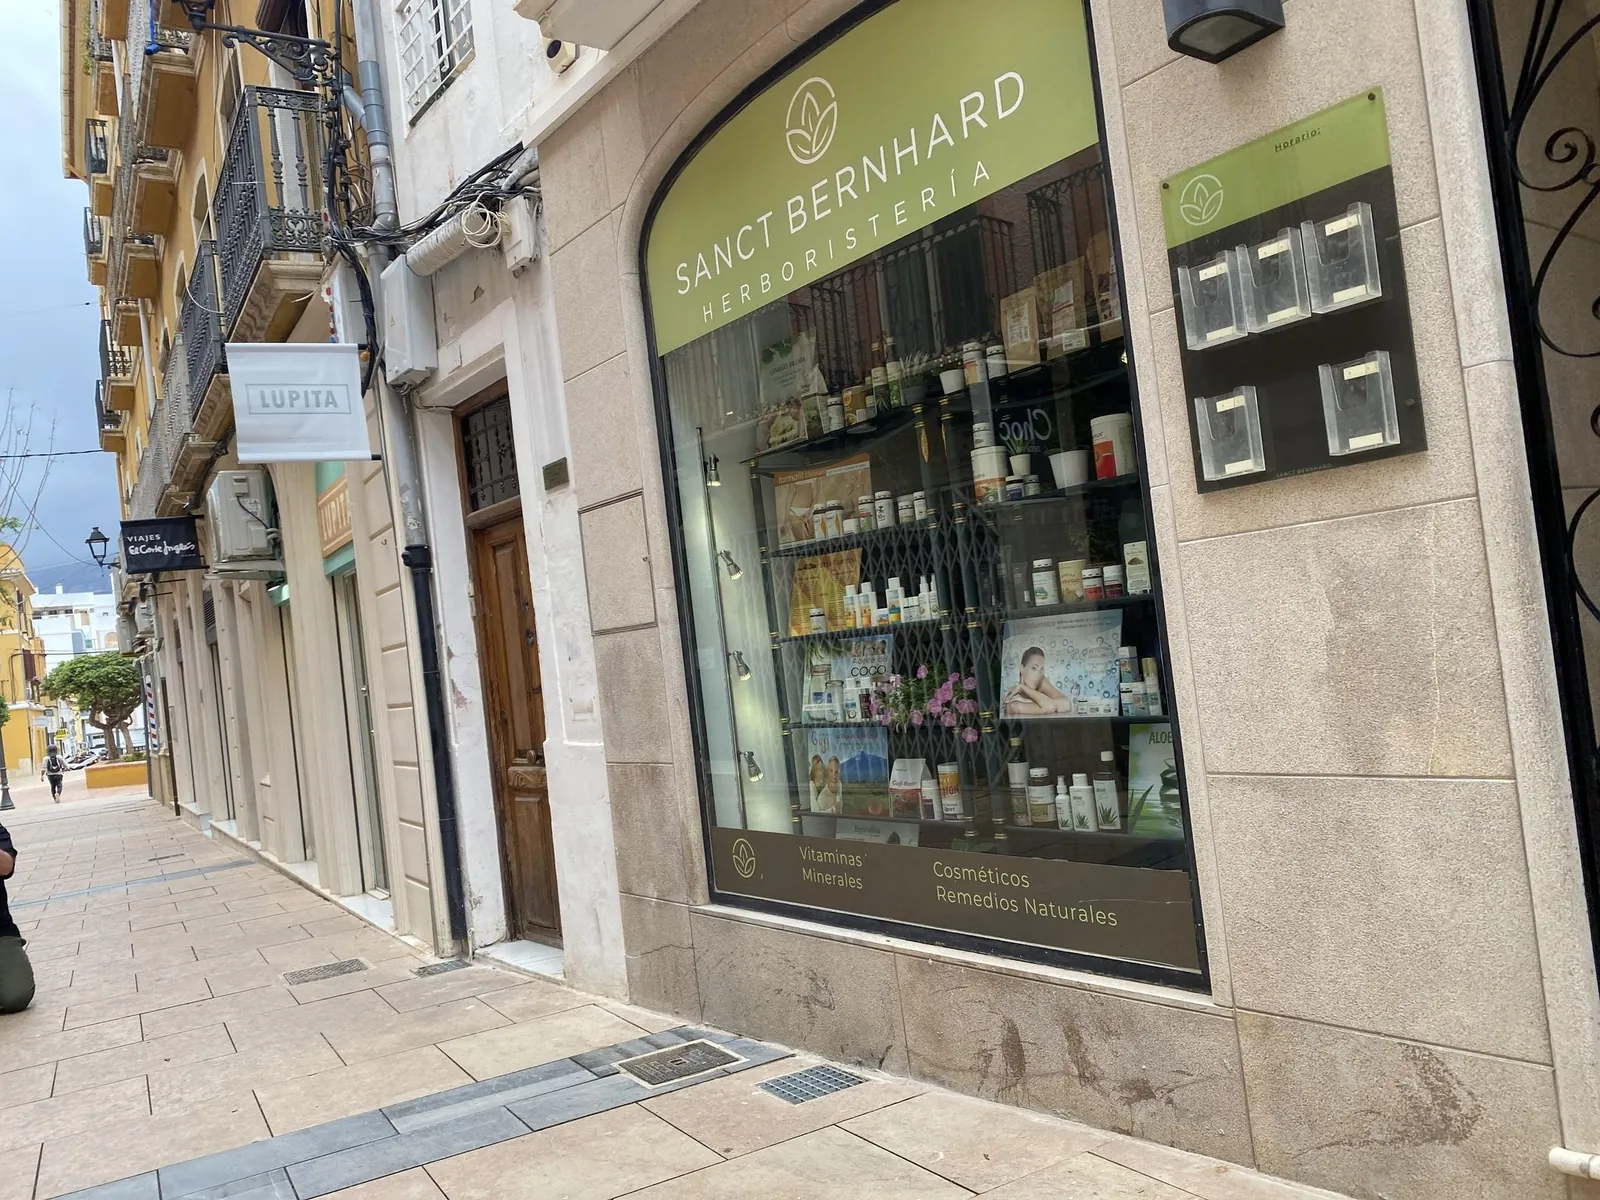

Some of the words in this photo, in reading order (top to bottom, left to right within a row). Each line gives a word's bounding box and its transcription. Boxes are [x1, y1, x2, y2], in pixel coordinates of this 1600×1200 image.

[1274, 127, 1321, 153] Horario:
[675, 210, 774, 296] SANCT
[786, 70, 1026, 235] BERNHARD
[701, 160, 991, 323] HERBORISTERÍA
[259, 389, 339, 409] LUPITA
[126, 532, 162, 543] VIAJES
[128, 544, 140, 556] El
[140, 543, 164, 555] Corte
[163, 540, 196, 556] Inglés
[851, 665, 886, 677] COCO
[1148, 731, 1172, 745] ALOE
[799, 845, 863, 868] Vitaminas
[801, 867, 863, 891] Minerales
[932, 860, 1030, 889] Cosméticos
[935, 885, 1019, 913] Remedios
[1023, 897, 1118, 928] Naturales
